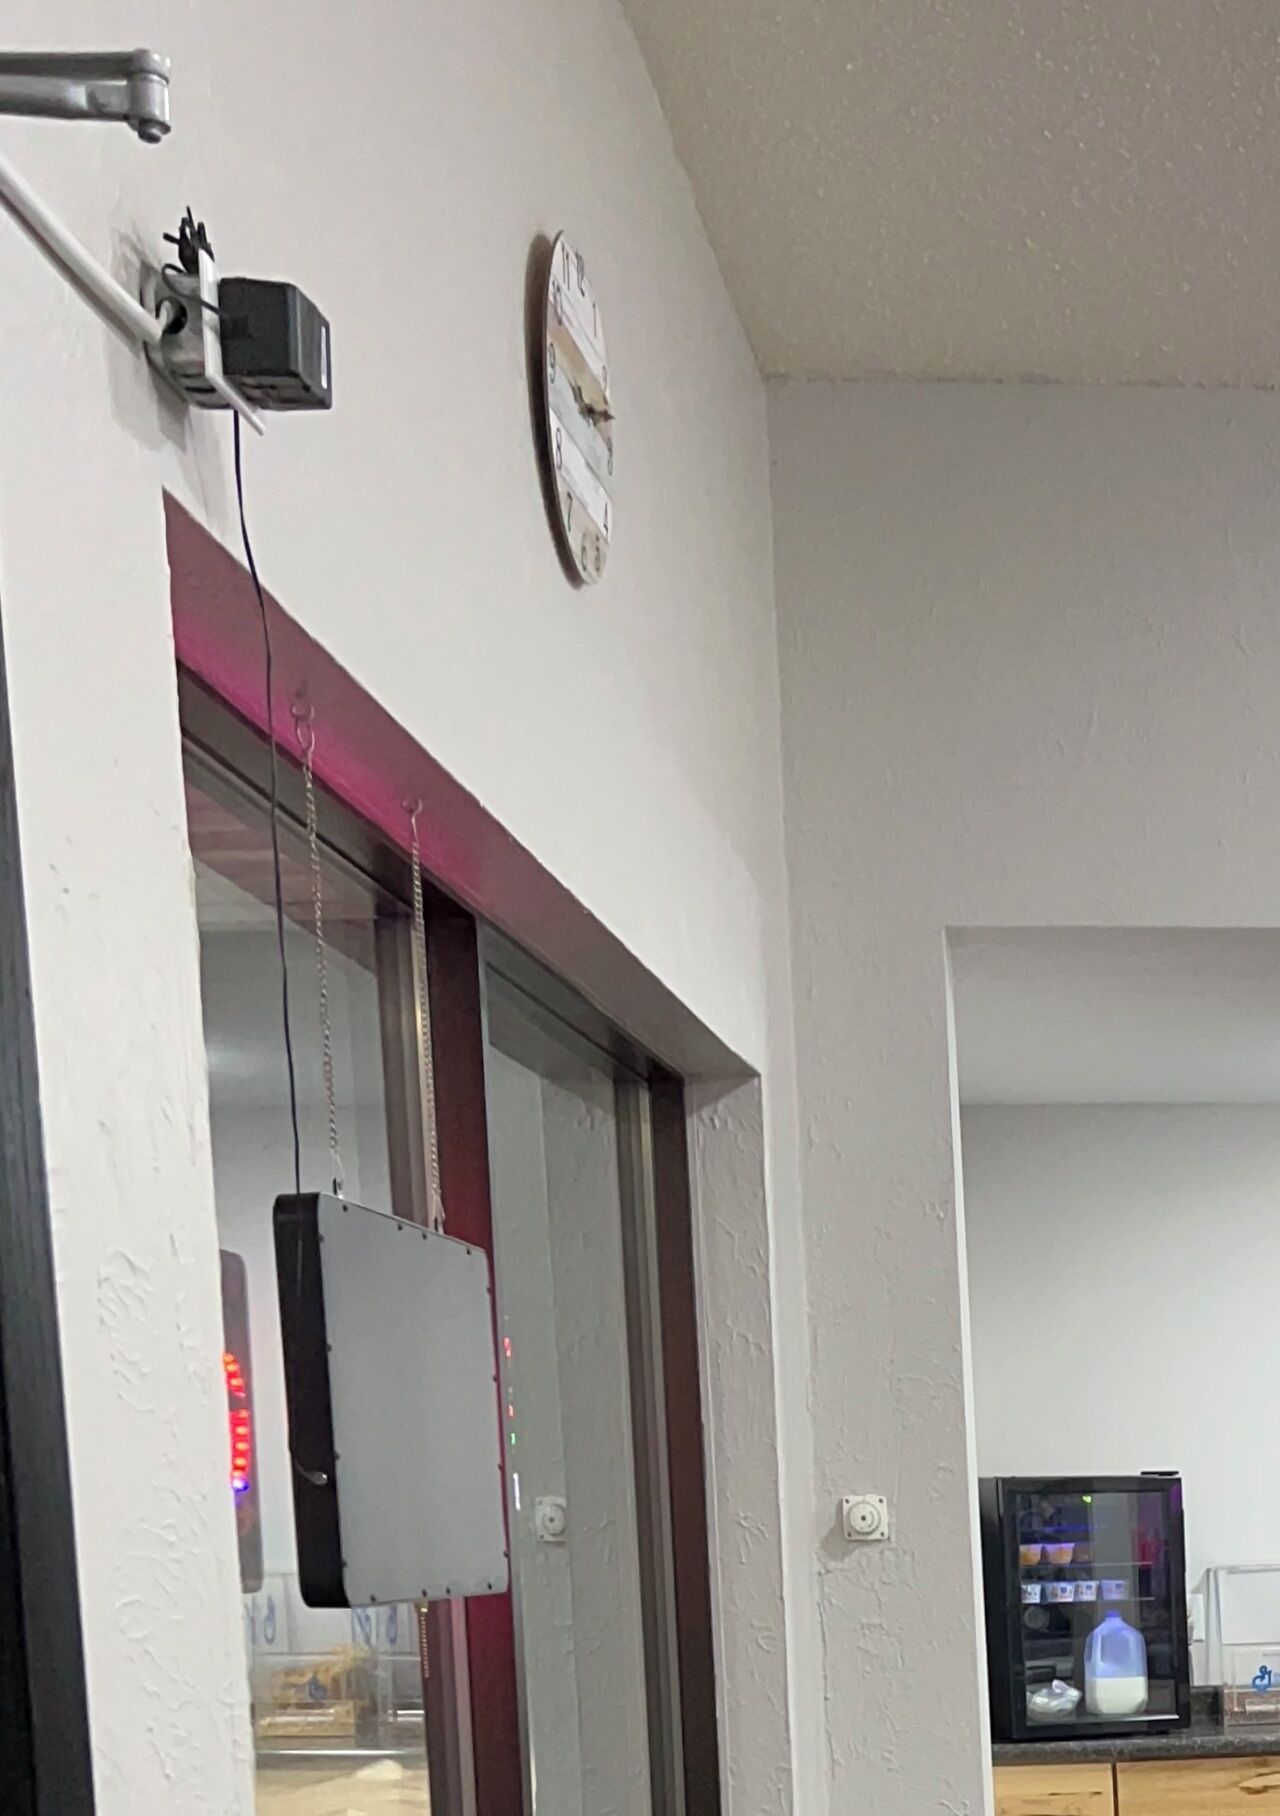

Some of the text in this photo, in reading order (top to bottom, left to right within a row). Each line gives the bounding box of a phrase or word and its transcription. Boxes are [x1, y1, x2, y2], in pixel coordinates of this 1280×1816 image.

[561, 242, 571, 291] 11
[549, 341, 557, 384] 9
[555, 427, 563, 470] 8
[566, 491, 574, 533] 7
